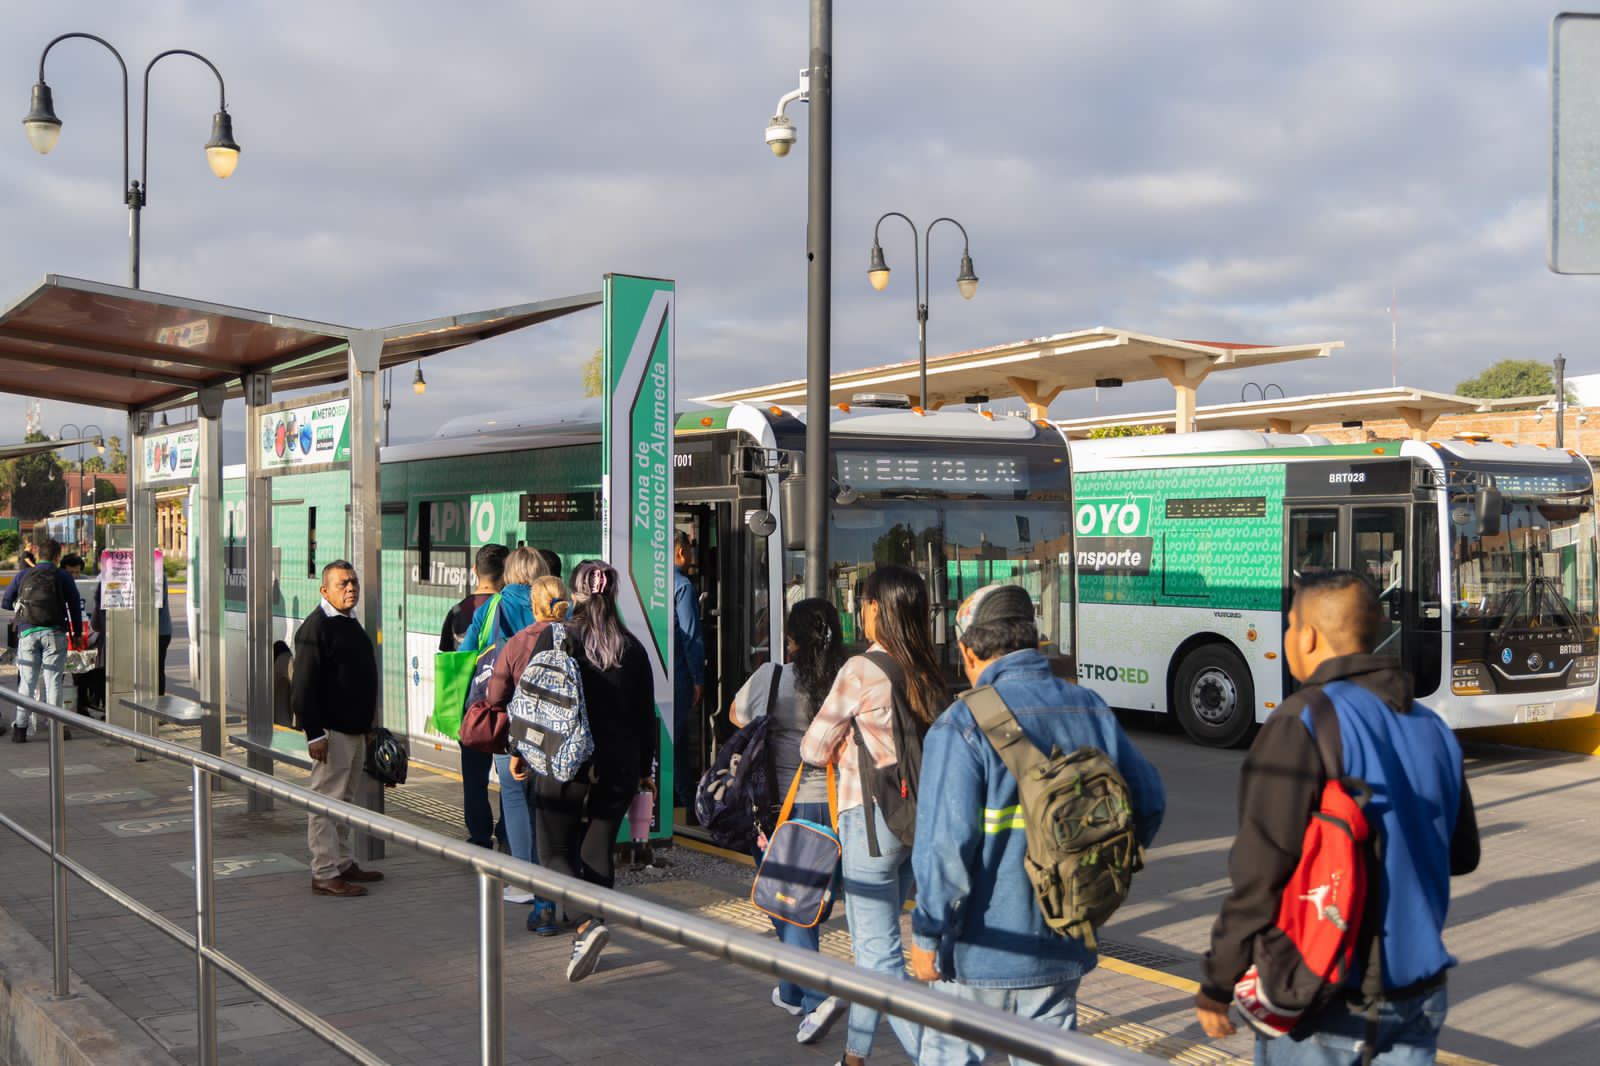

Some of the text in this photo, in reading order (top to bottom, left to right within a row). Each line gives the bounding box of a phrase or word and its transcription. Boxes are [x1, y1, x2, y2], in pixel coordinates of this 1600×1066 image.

[674, 454, 692, 467] T001
[635, 441, 650, 529] Zona de
[650, 362, 666, 610] Transferencia Alameda
[1329, 472, 1366, 483] BRT028
[1076, 503, 1140, 534] OYO
[1058, 549, 1141, 571] ransporte
[1078, 663, 1149, 685] ETRORED
